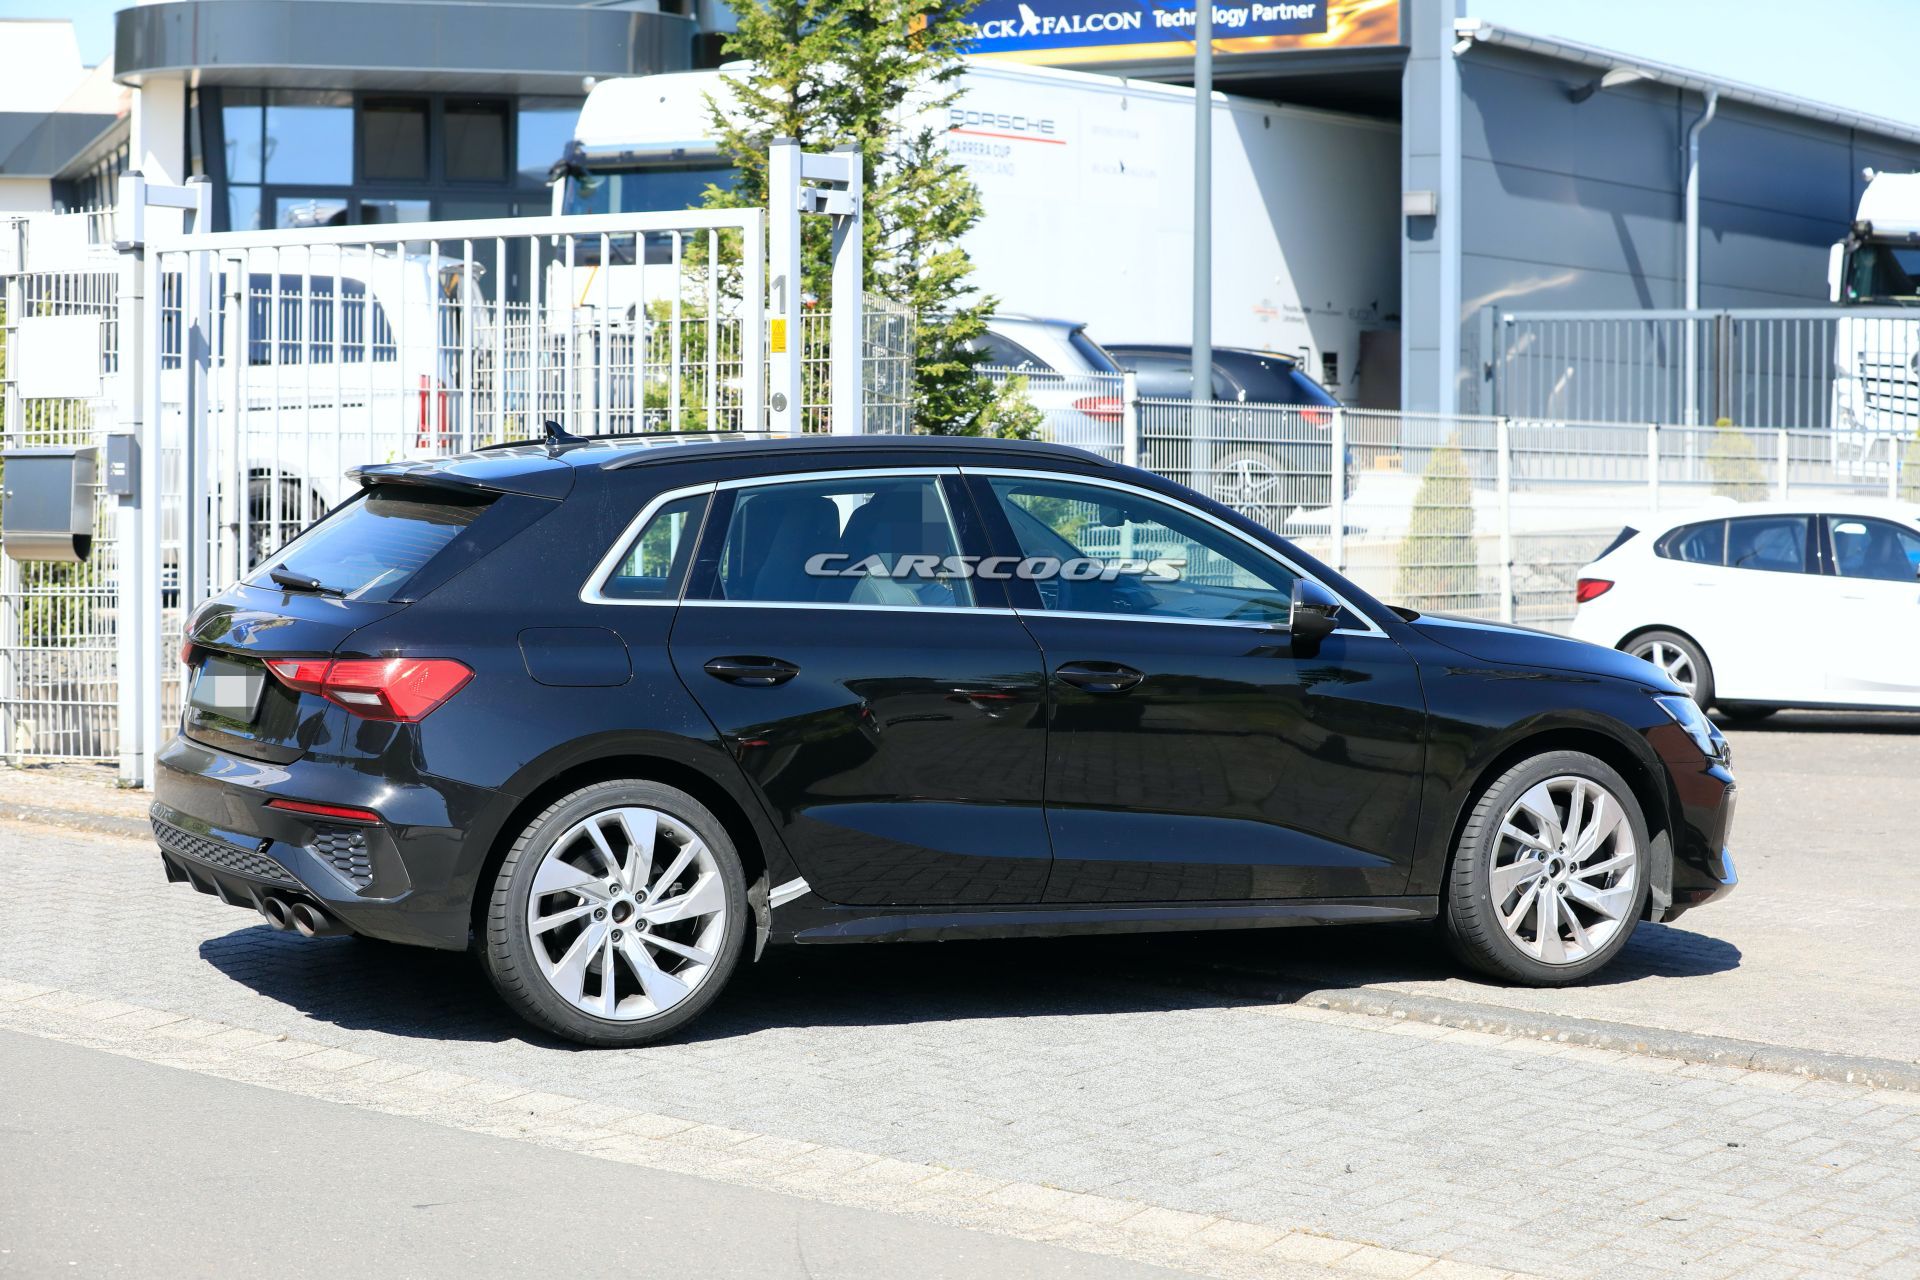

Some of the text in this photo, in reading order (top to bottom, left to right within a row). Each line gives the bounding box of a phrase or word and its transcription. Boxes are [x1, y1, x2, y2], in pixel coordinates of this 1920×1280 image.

[1041, 11, 1142, 35] FALCON
[1252, 3, 1317, 22] Partner
[950, 109, 1055, 134] PORSCHE
[949, 140, 1011, 158] CARRERA CUP
[771, 274, 786, 315] 1
